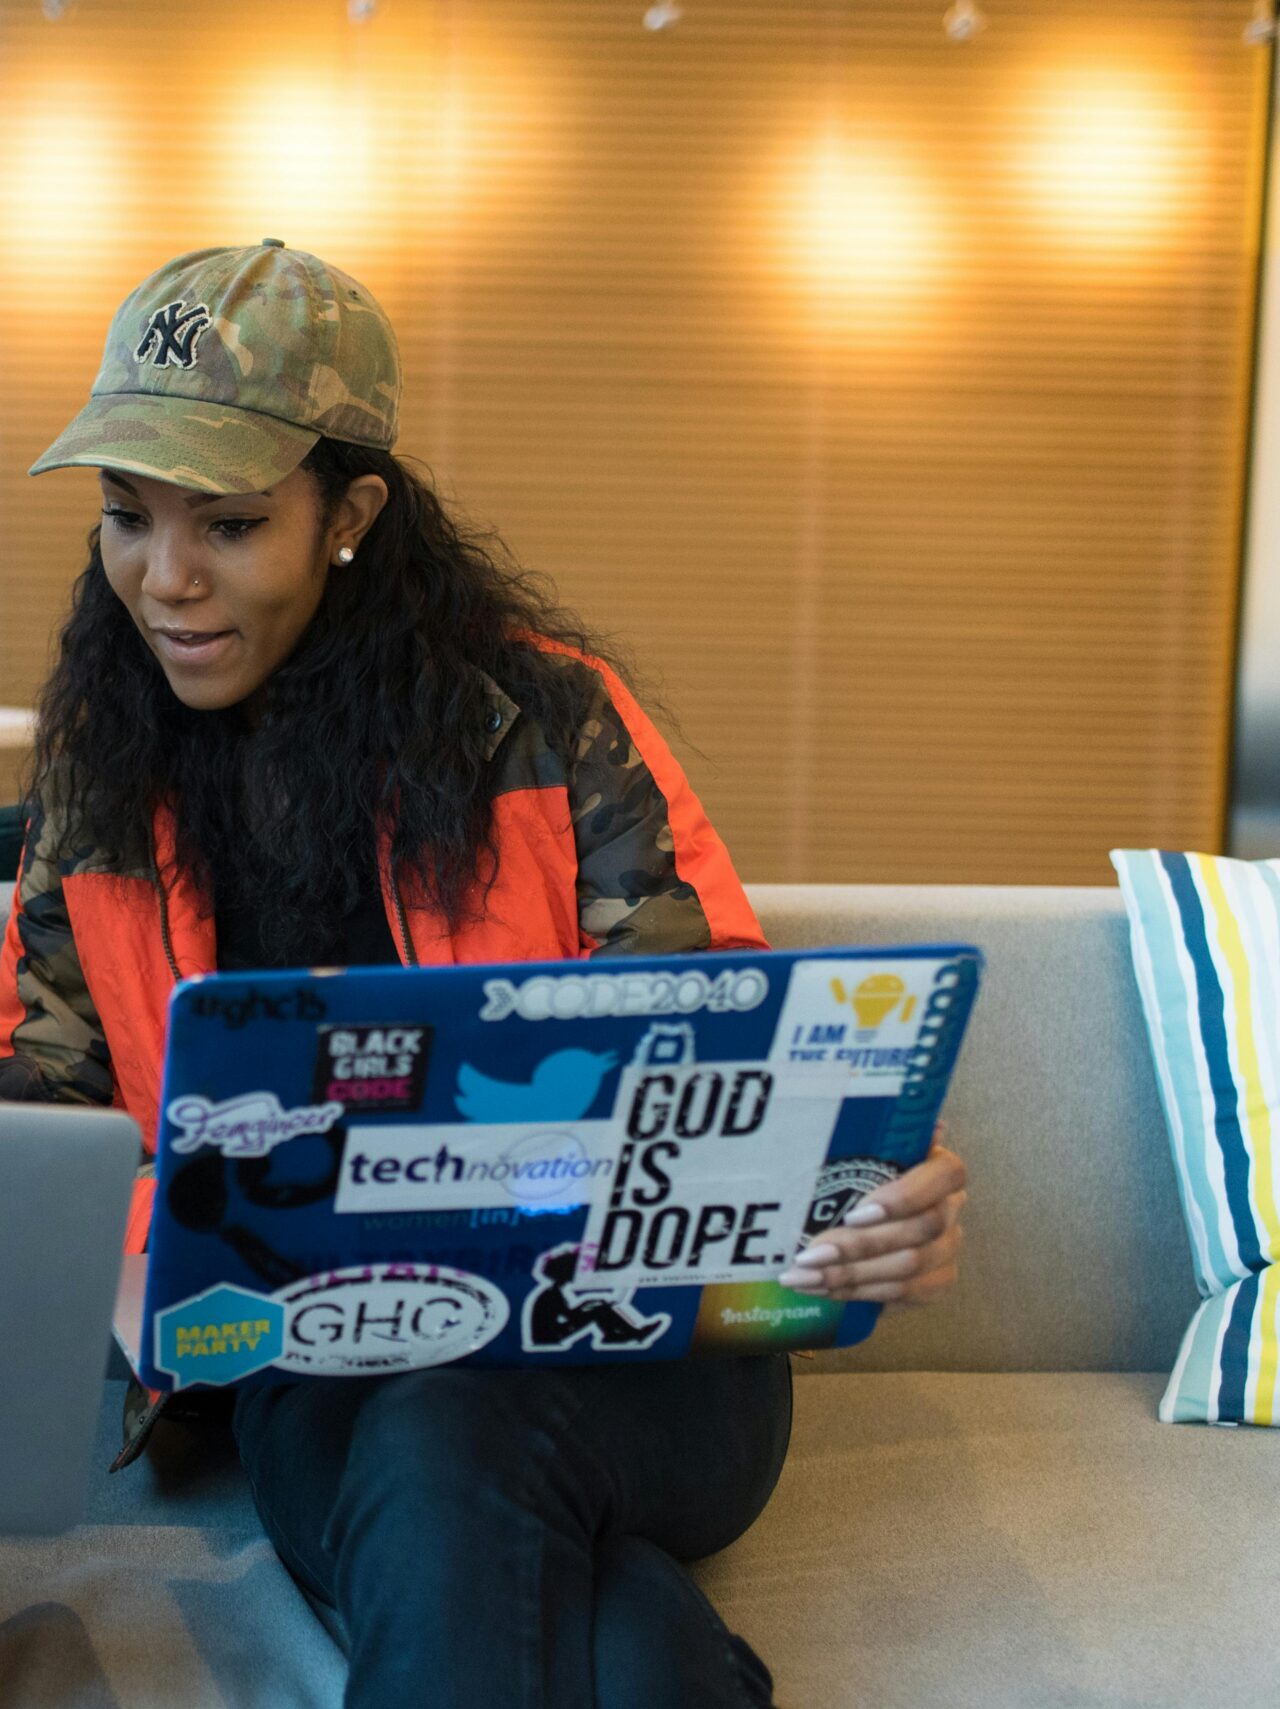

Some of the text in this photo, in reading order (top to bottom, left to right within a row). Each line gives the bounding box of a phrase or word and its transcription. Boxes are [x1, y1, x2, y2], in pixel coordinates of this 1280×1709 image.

[328, 1028, 423, 1056] BLACK
[792, 1024, 847, 1045] I AM
[332, 1054, 413, 1080] GIRLS
[325, 1078, 412, 1102] CODE
[626, 1070, 774, 1141] GOD
[609, 1141, 681, 1208] IS
[592, 1202, 786, 1273] DOPE.
[289, 1297, 464, 1346] GHC
[720, 1306, 822, 1328] Instagram
[176, 1319, 271, 1342] MAKER
[176, 1337, 262, 1359] PARTY
